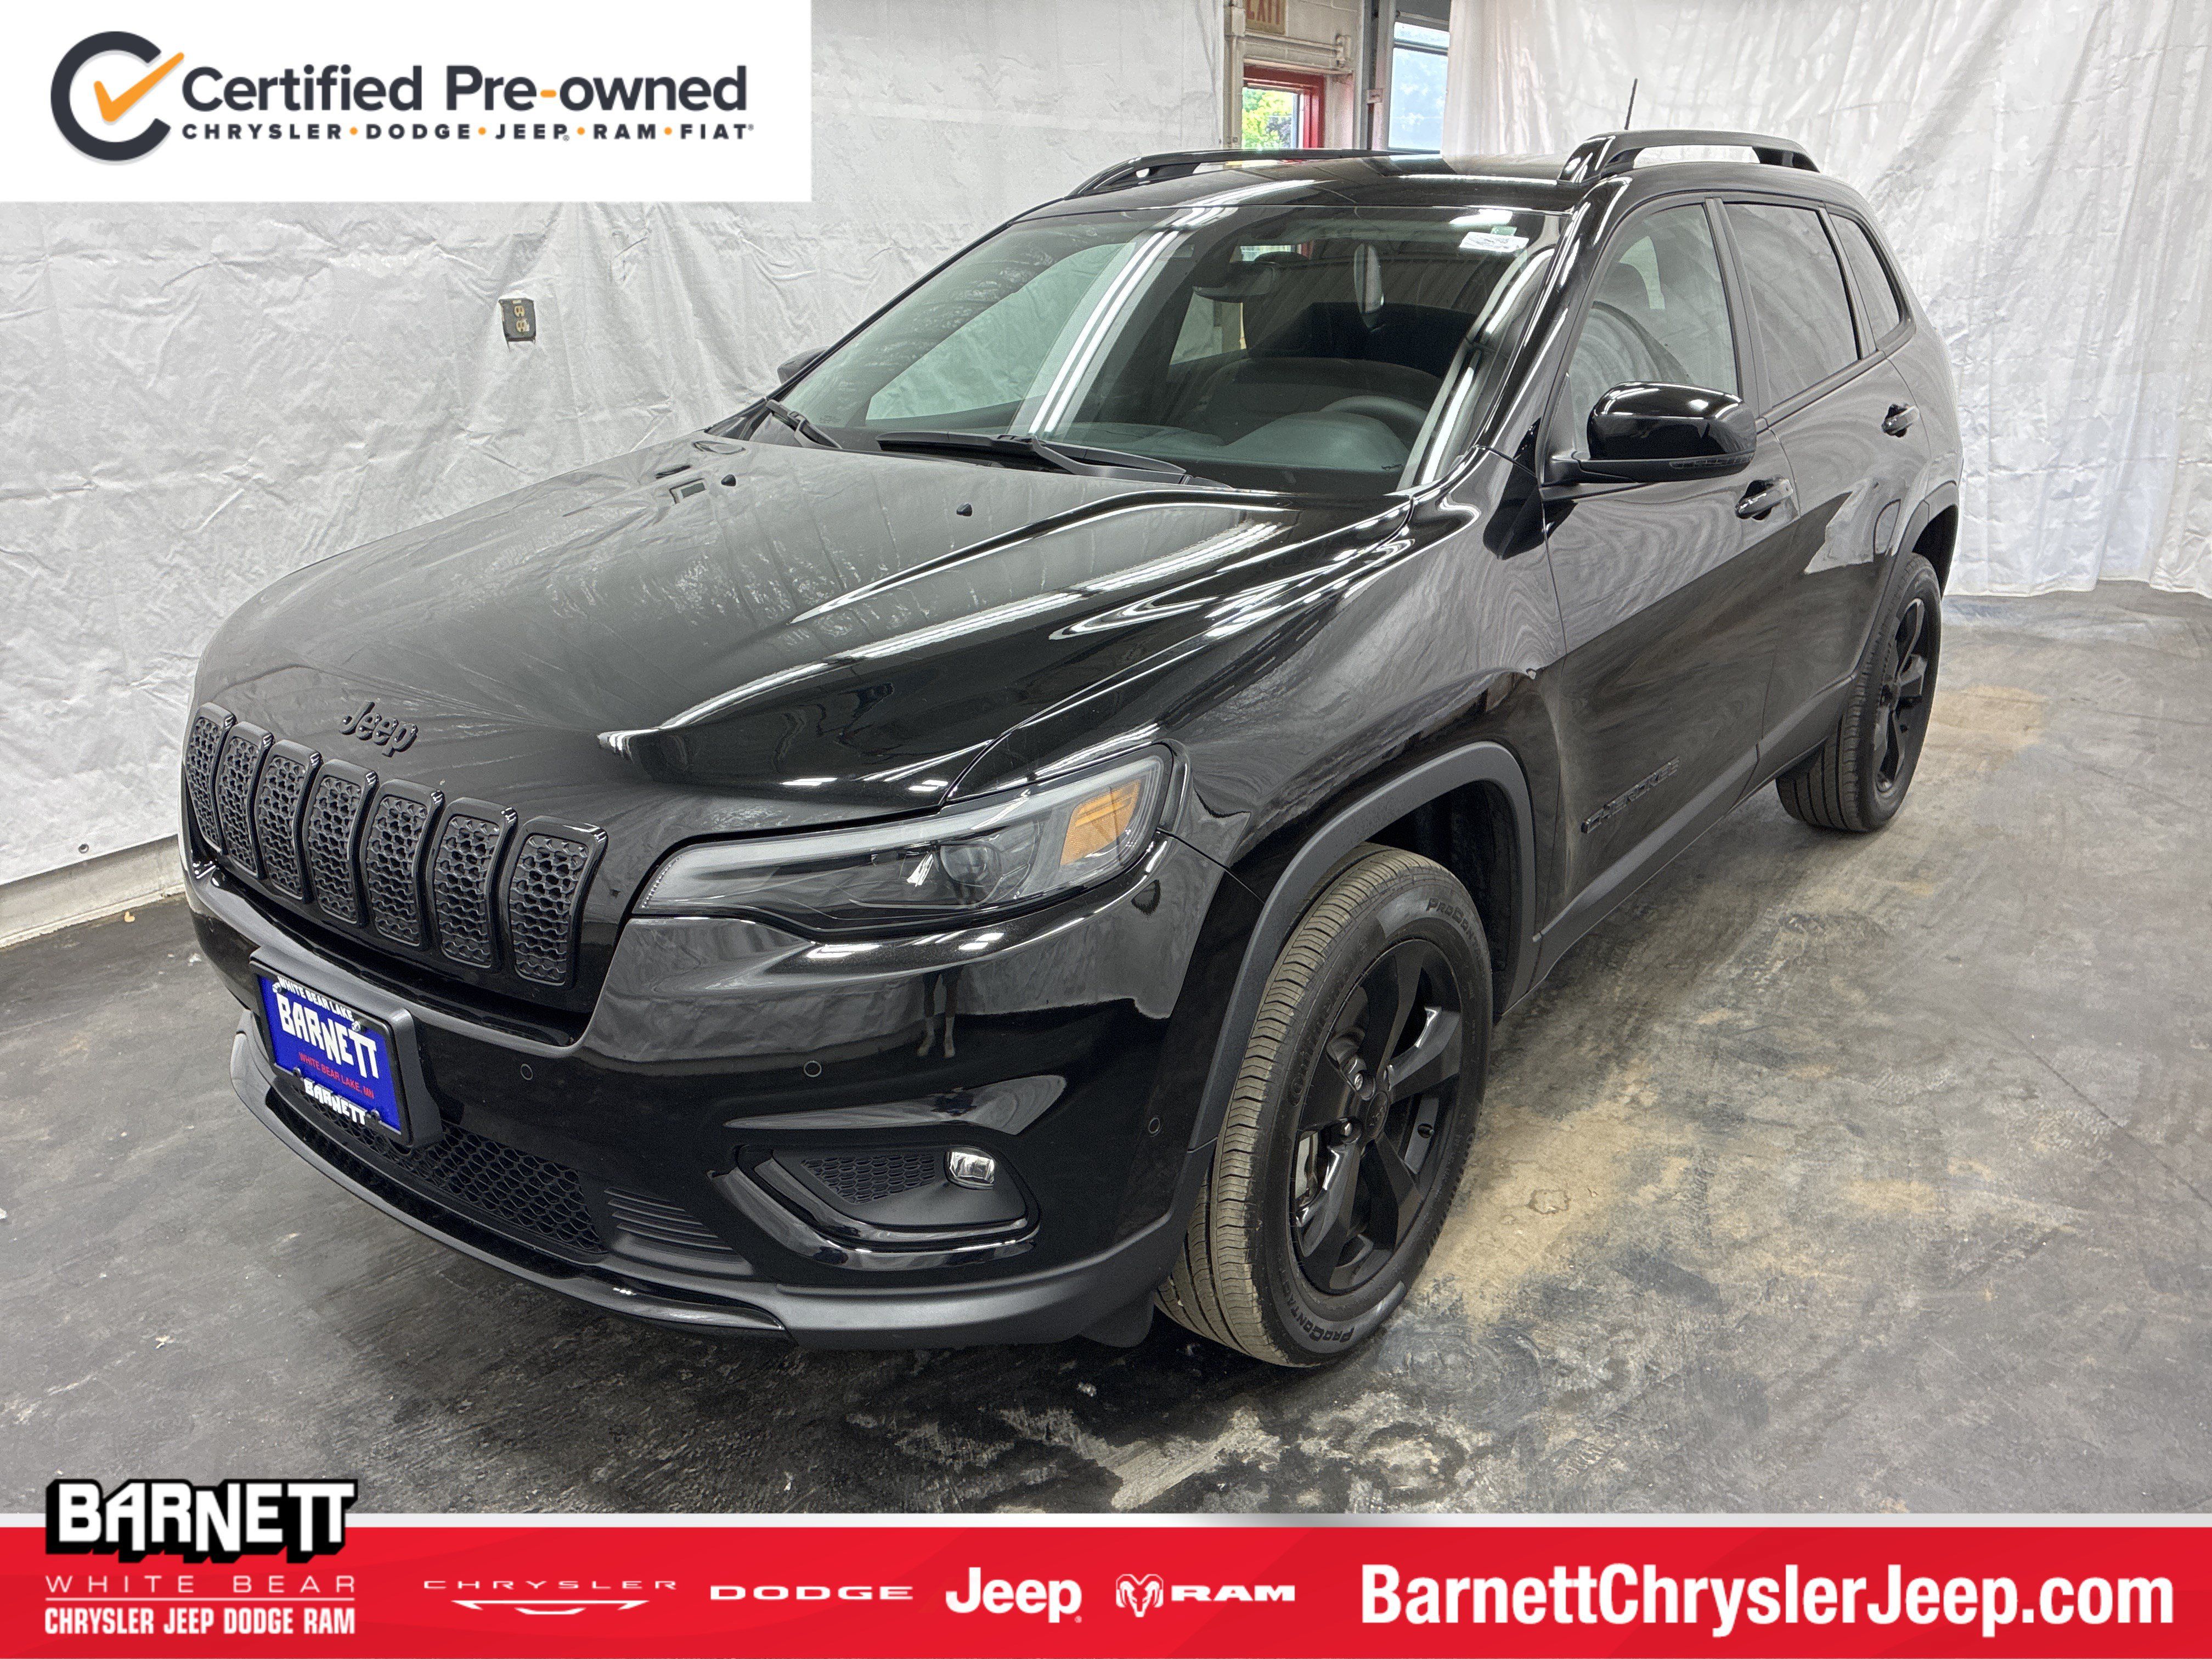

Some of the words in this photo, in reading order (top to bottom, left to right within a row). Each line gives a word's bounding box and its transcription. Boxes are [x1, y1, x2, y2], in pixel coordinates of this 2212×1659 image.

[338, 701, 419, 758] Jeep
[277, 975, 306, 999] WHITE
[305, 988, 331, 1011] BEAR
[330, 1001, 354, 1022] LAKE
[276, 992, 379, 1079] BARNETT
[299, 1052, 320, 1071] WHITE
[321, 1063, 341, 1082] BEAR
[303, 1077, 368, 1125] BARNETT
